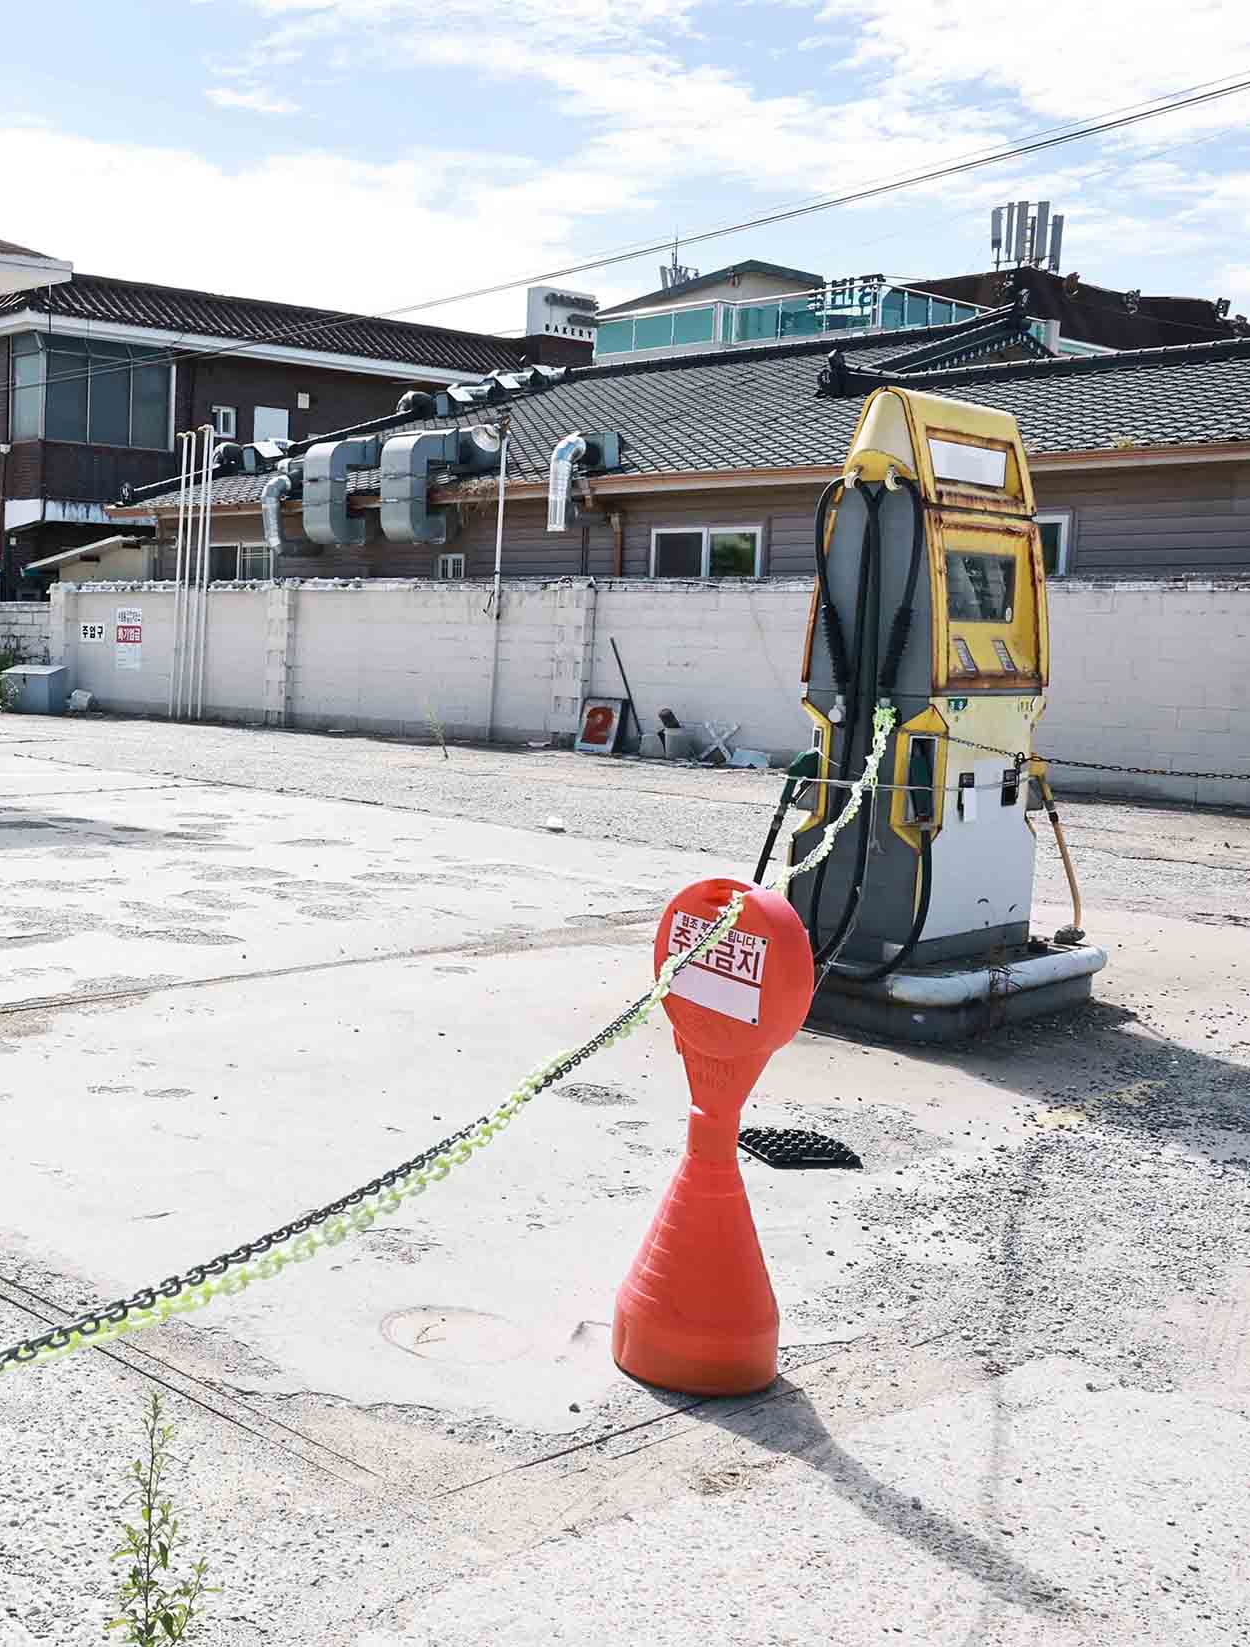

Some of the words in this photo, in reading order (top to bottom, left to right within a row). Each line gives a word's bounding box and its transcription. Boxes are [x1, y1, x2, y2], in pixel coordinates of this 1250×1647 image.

[545, 323, 592, 339] BAKERY
[82, 625, 103, 639] 주입구
[581, 706, 615, 745] 2
[701, 921, 756, 949] 부립니다
